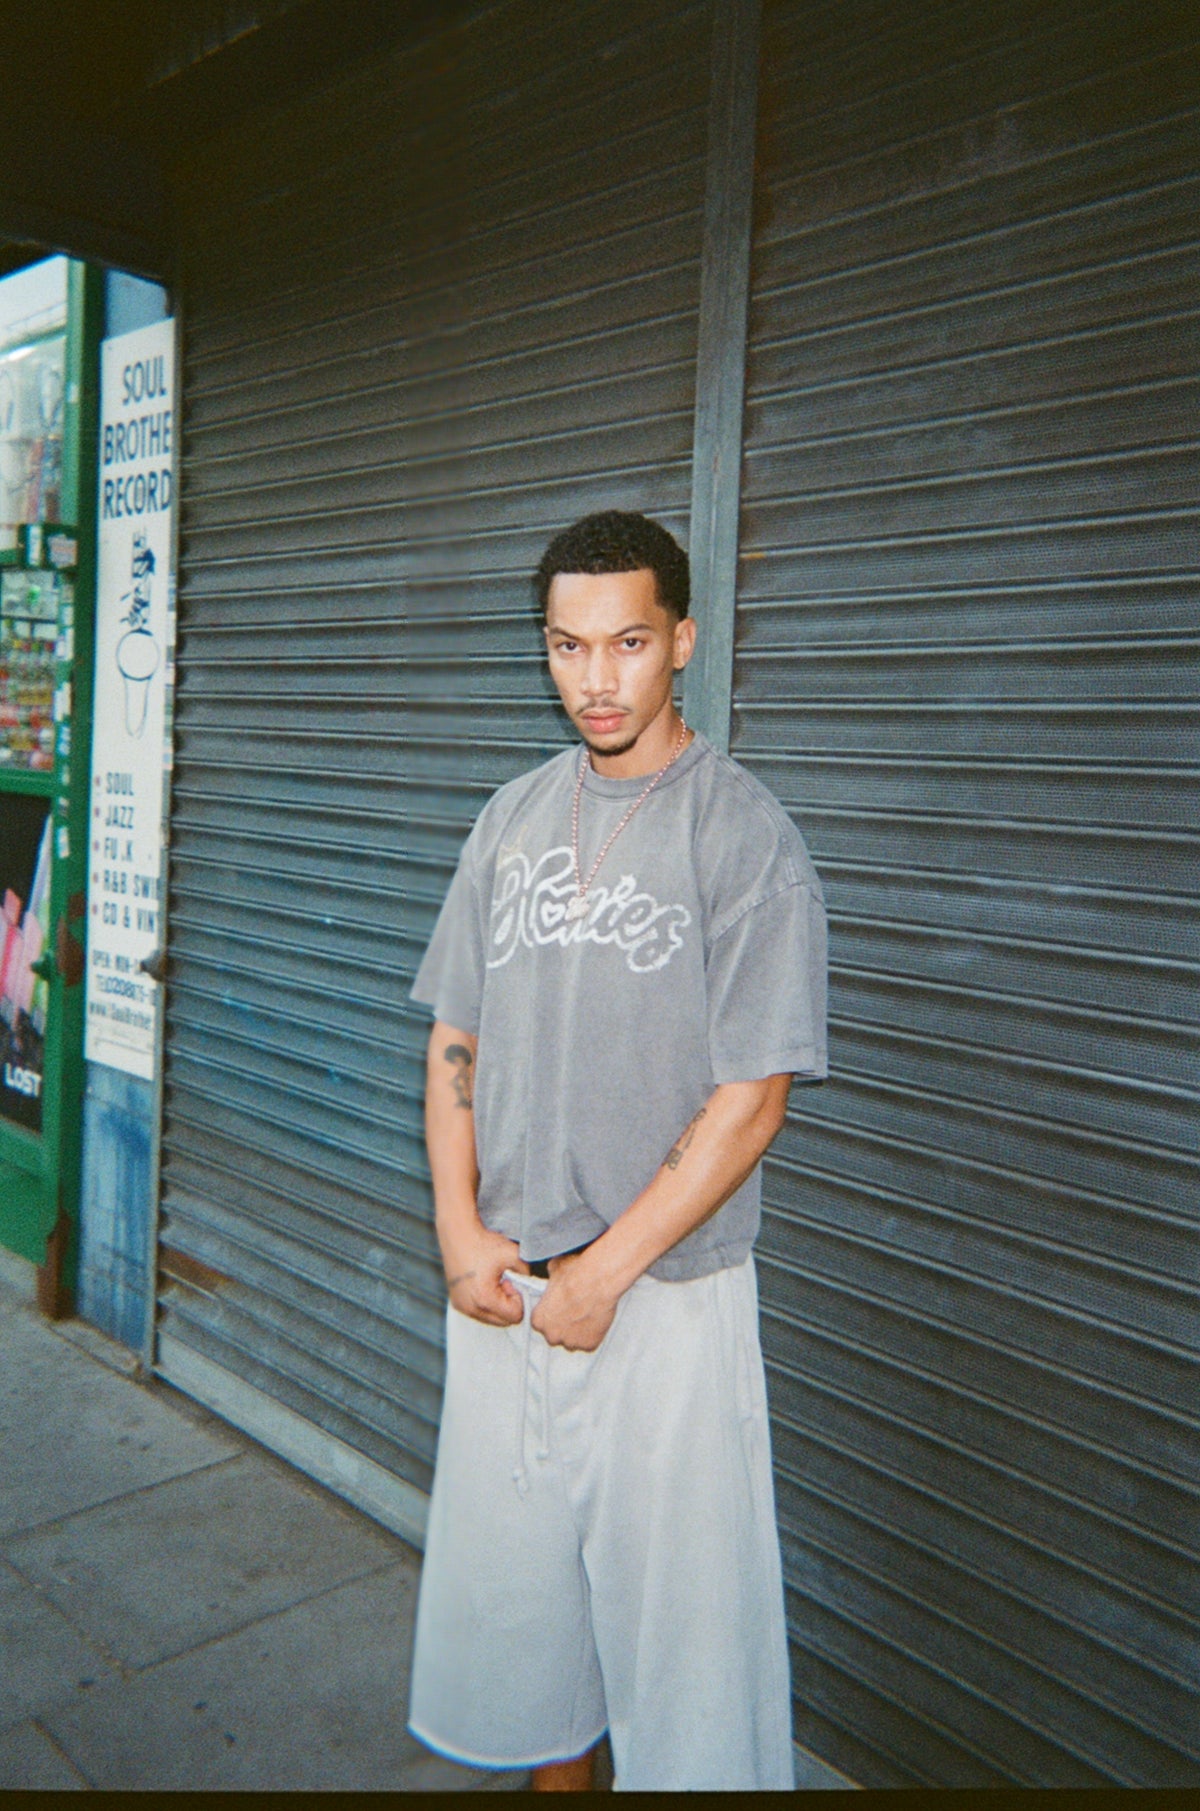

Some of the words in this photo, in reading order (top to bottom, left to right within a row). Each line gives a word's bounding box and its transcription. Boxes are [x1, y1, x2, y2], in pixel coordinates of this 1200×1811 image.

[122, 355, 167, 406] SOUL
[103, 411, 172, 466] BROTHE
[103, 468, 172, 519] RECORD
[106, 772, 134, 796] SOUL
[105, 805, 134, 829] JAZZ
[104, 837, 133, 862] FUK
[104, 869, 127, 894] R&B
[103, 901, 117, 925] CD
[123, 905, 131, 929] &
[4, 1062, 42, 1098] LOST
